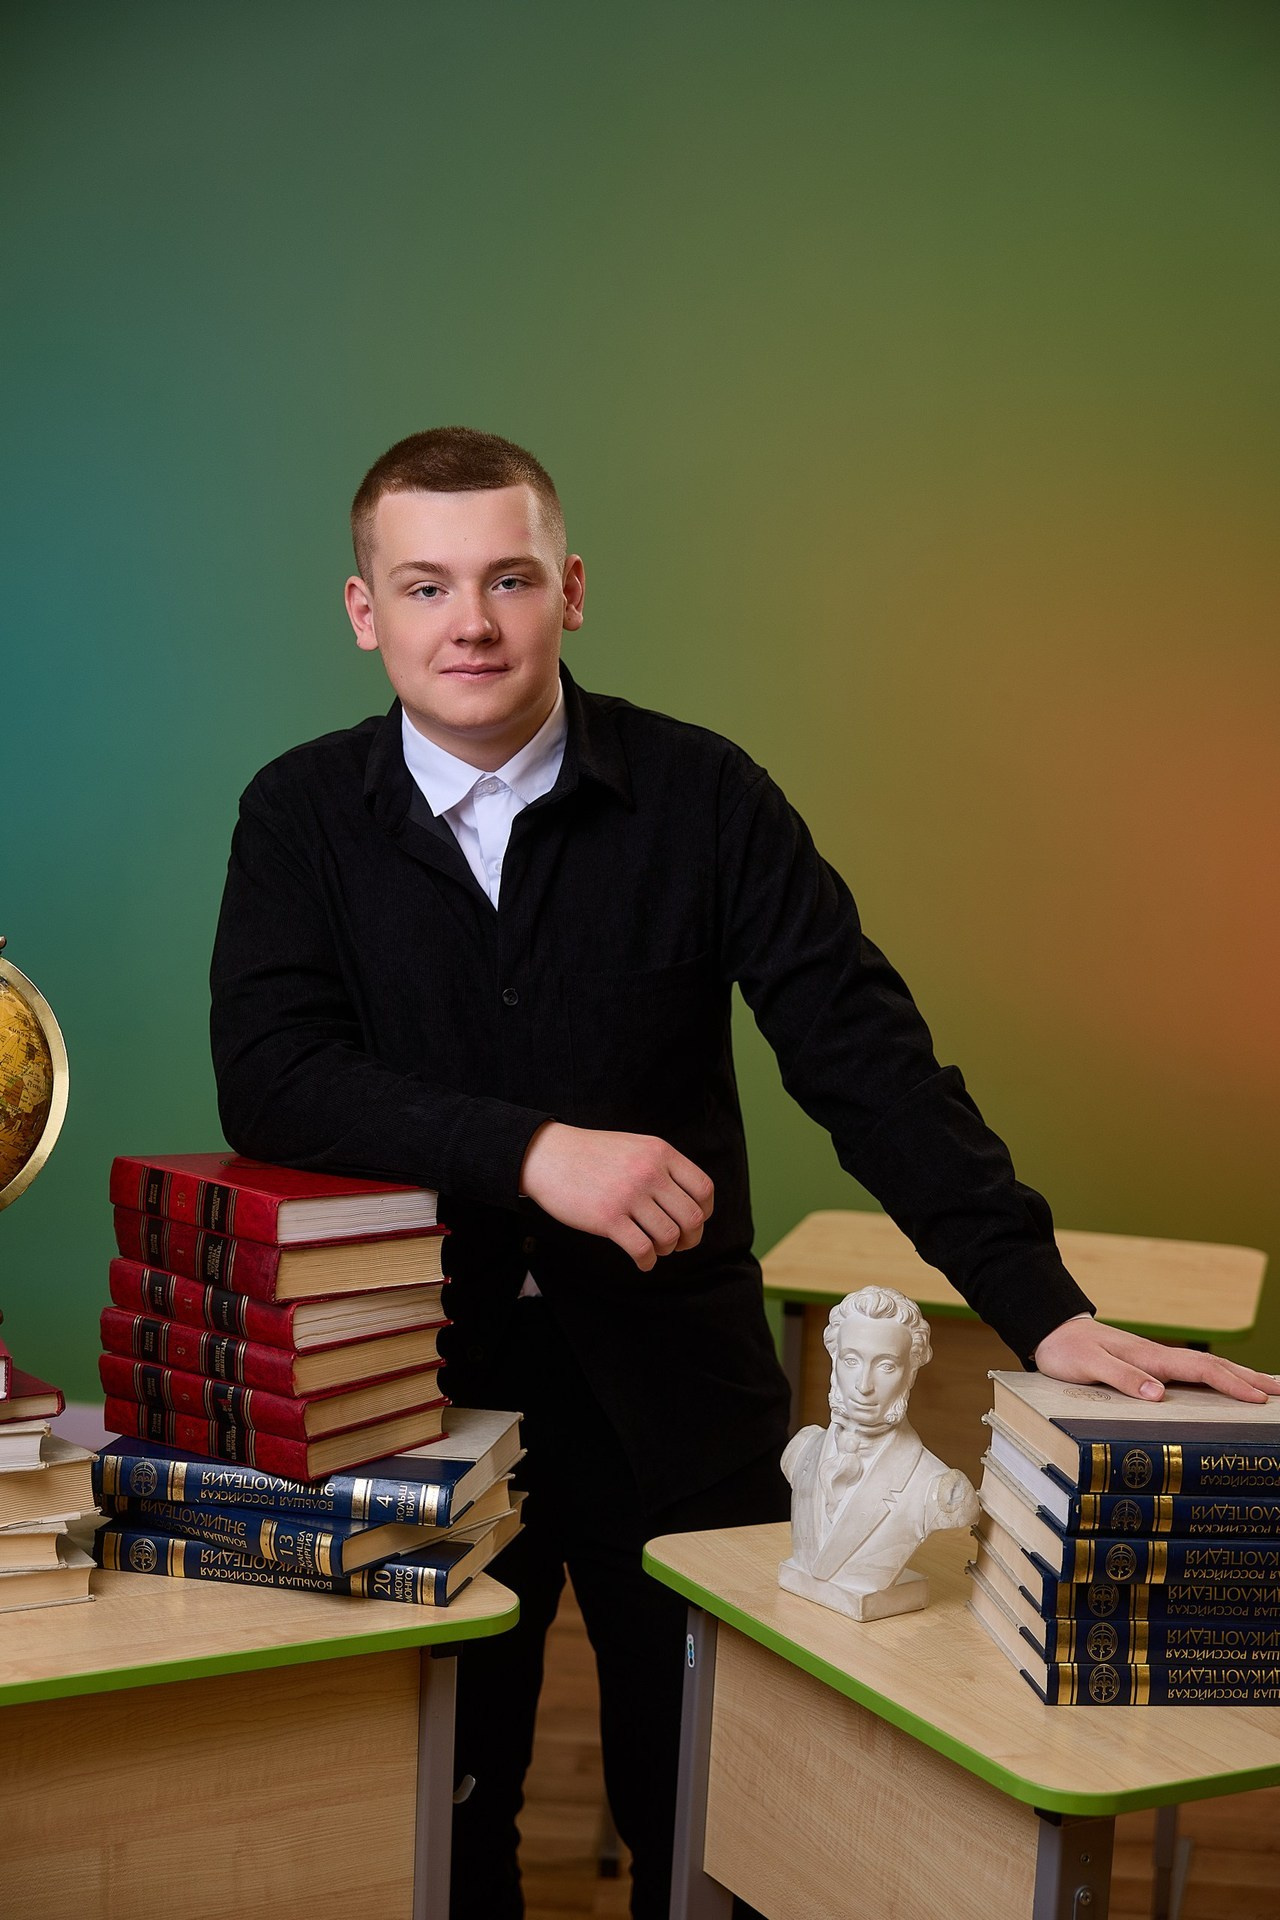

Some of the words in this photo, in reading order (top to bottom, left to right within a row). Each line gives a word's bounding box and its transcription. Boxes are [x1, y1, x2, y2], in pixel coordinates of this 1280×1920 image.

[200, 1489, 274, 1505] РОССИЙСКАЯ
[280, 1496, 334, 1511] БОЛЬШАЯ
[376, 1495, 393, 1508] 4
[396, 1485, 408, 1521] БОЛЬШ
[406, 1491, 416, 1517] ВЕЛИ
[203, 1531, 248, 1548] БОЛЬШАЯ
[279, 1535, 294, 1556] 13
[296, 1531, 306, 1567] КАНЦЕЛ
[304, 1533, 314, 1568] КИРГИЗ
[200, 1566, 274, 1583] РОССИЙСКАЯ
[278, 1576, 333, 1590] БОЛЬШАЯ
[374, 1569, 392, 1595] 20
[1184, 1569, 1265, 1580] РОССИЙСКАЯ
[394, 1569, 405, 1600] МЕОТС
[404, 1566, 414, 1602] МОНГОЛ
[1167, 1604, 1249, 1616] РОССИЙСКАЯ
[1166, 1649, 1247, 1660] РОССИЙСКАЯ
[1167, 1688, 1249, 1700] РОССИЙСКАЯ
